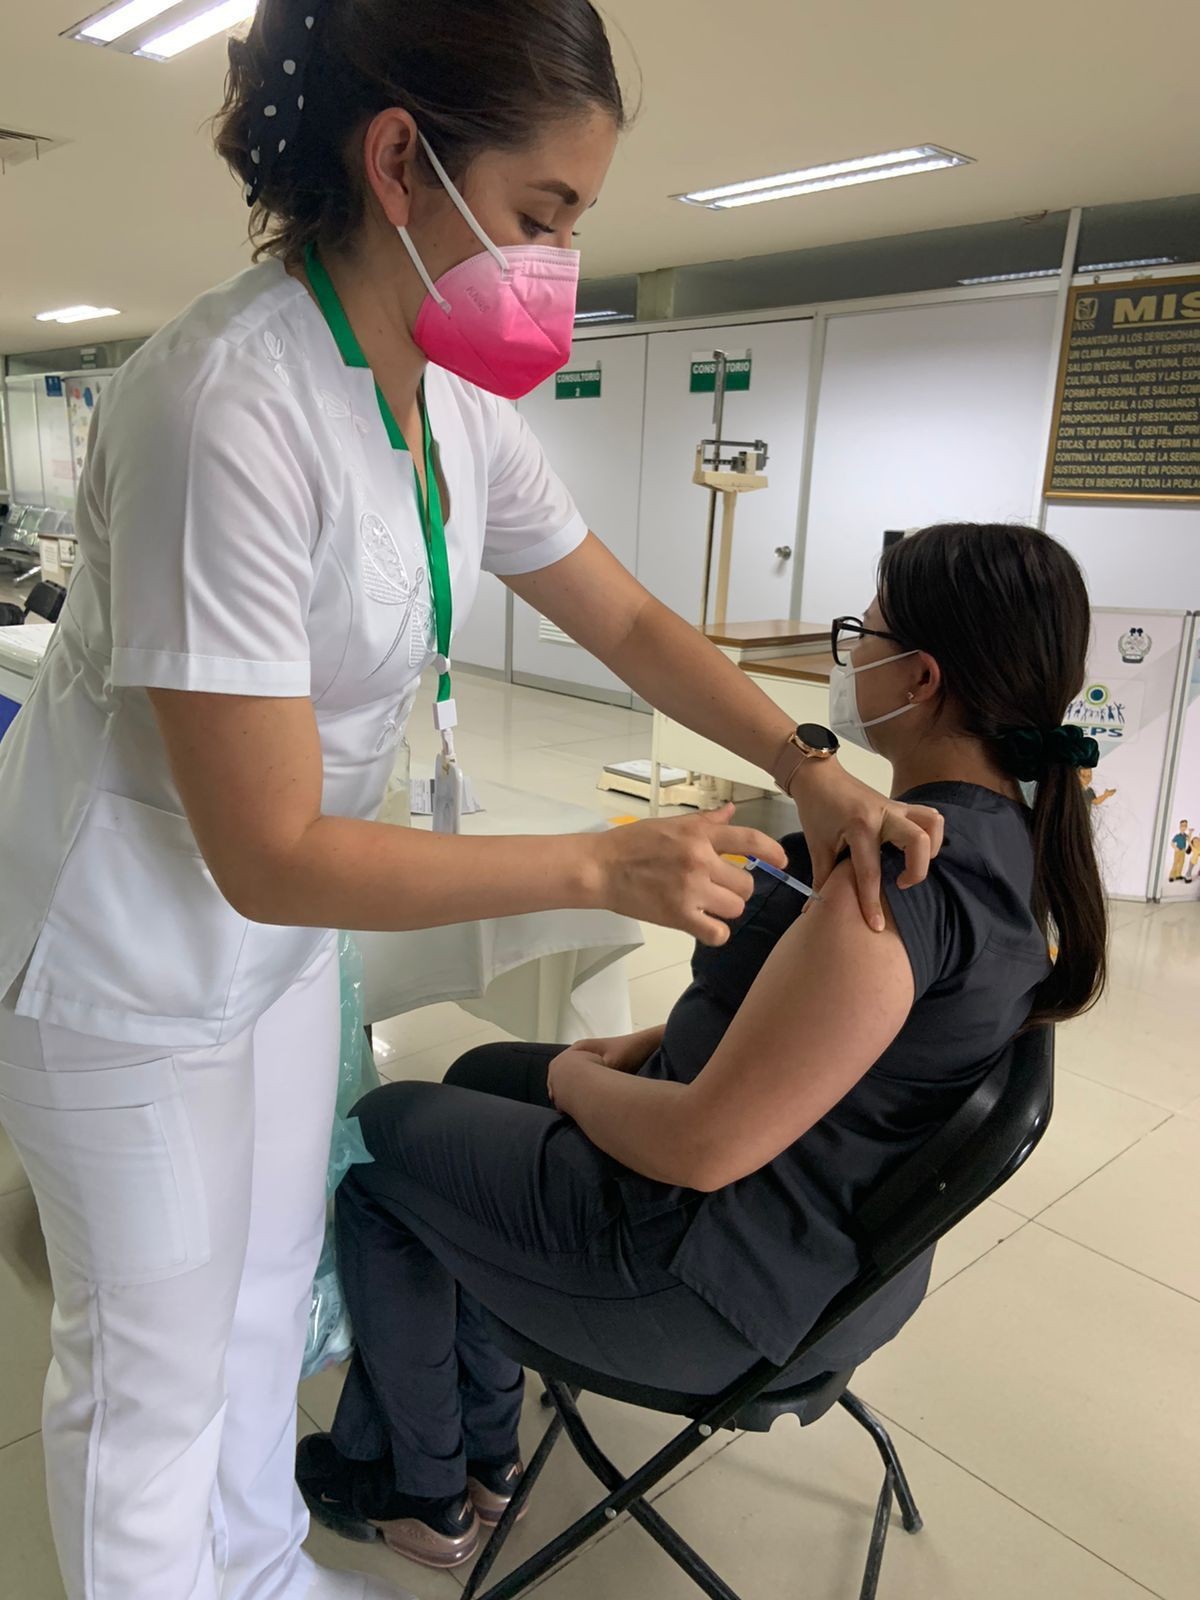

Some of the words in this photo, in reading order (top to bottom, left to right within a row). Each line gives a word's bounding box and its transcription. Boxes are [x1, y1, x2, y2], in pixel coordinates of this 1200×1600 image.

[1113, 291, 1200, 323] MIS
[1126, 333, 1143, 343] LOS
[1081, 348, 1104, 359] CLIMA
[1105, 345, 1153, 357] AGRADABLE
[1154, 345, 1160, 355] Y
[692, 361, 750, 375] CONSTORIO
[1067, 362, 1092, 373] SALUD
[557, 371, 600, 384] CONSULTORIO
[1103, 373, 1119, 384] LOS
[1120, 371, 1156, 383] VALORES
[1158, 371, 1164, 382] Y
[1164, 370, 1181, 381] LAS
[1064, 388, 1095, 398] FORMAR
[1096, 386, 1137, 397] PERSONAL
[1140, 386, 1150, 396] DE
[1151, 385, 1179, 395] SALUD
[1062, 401, 1073, 411] DE
[1073, 400, 1109, 411] SERVICIO
[1109, 399, 1129, 410] LEAL
[1130, 399, 1138, 409] A
[1138, 399, 1153, 409] LOS
[1155, 398, 1196, 409] USUARIOS
[1060, 413, 1120, 424] PROPORCIONAR
[1121, 412, 1137, 423] LAS
[1138, 411, 1198, 422] PRESTACIONES
[1059, 427, 1075, 437] CON
[1077, 426, 1100, 436] TRATO
[1101, 425, 1133, 436] AMABLE
[1134, 426, 1140, 435] Y
[1086, 439, 1097, 449] DE
[1098, 439, 1121, 449] MODO
[1123, 439, 1137, 449] TAL
[1138, 439, 1155, 449] QUE
[1156, 438, 1190, 448] PERMITA
[1055, 452, 1092, 462] CONTINUA
[1093, 452, 1100, 461] Y
[1100, 452, 1144, 462] LIDERAZGO
[1145, 452, 1156, 462] DE
[1158, 452, 1168, 462] LA
[1054, 464, 1106, 475] SUSTENTADOS
[1107, 465, 1147, 475] MEDIANTE
[1148, 465, 1159, 475] UN
[1051, 477, 1084, 488] REDUNDE
[1085, 478, 1095, 488] EN
[1096, 478, 1133, 488] BENEFICIO
[1133, 478, 1140, 488] A
[1141, 478, 1160, 488] TODA
[1162, 478, 1172, 488] LA
